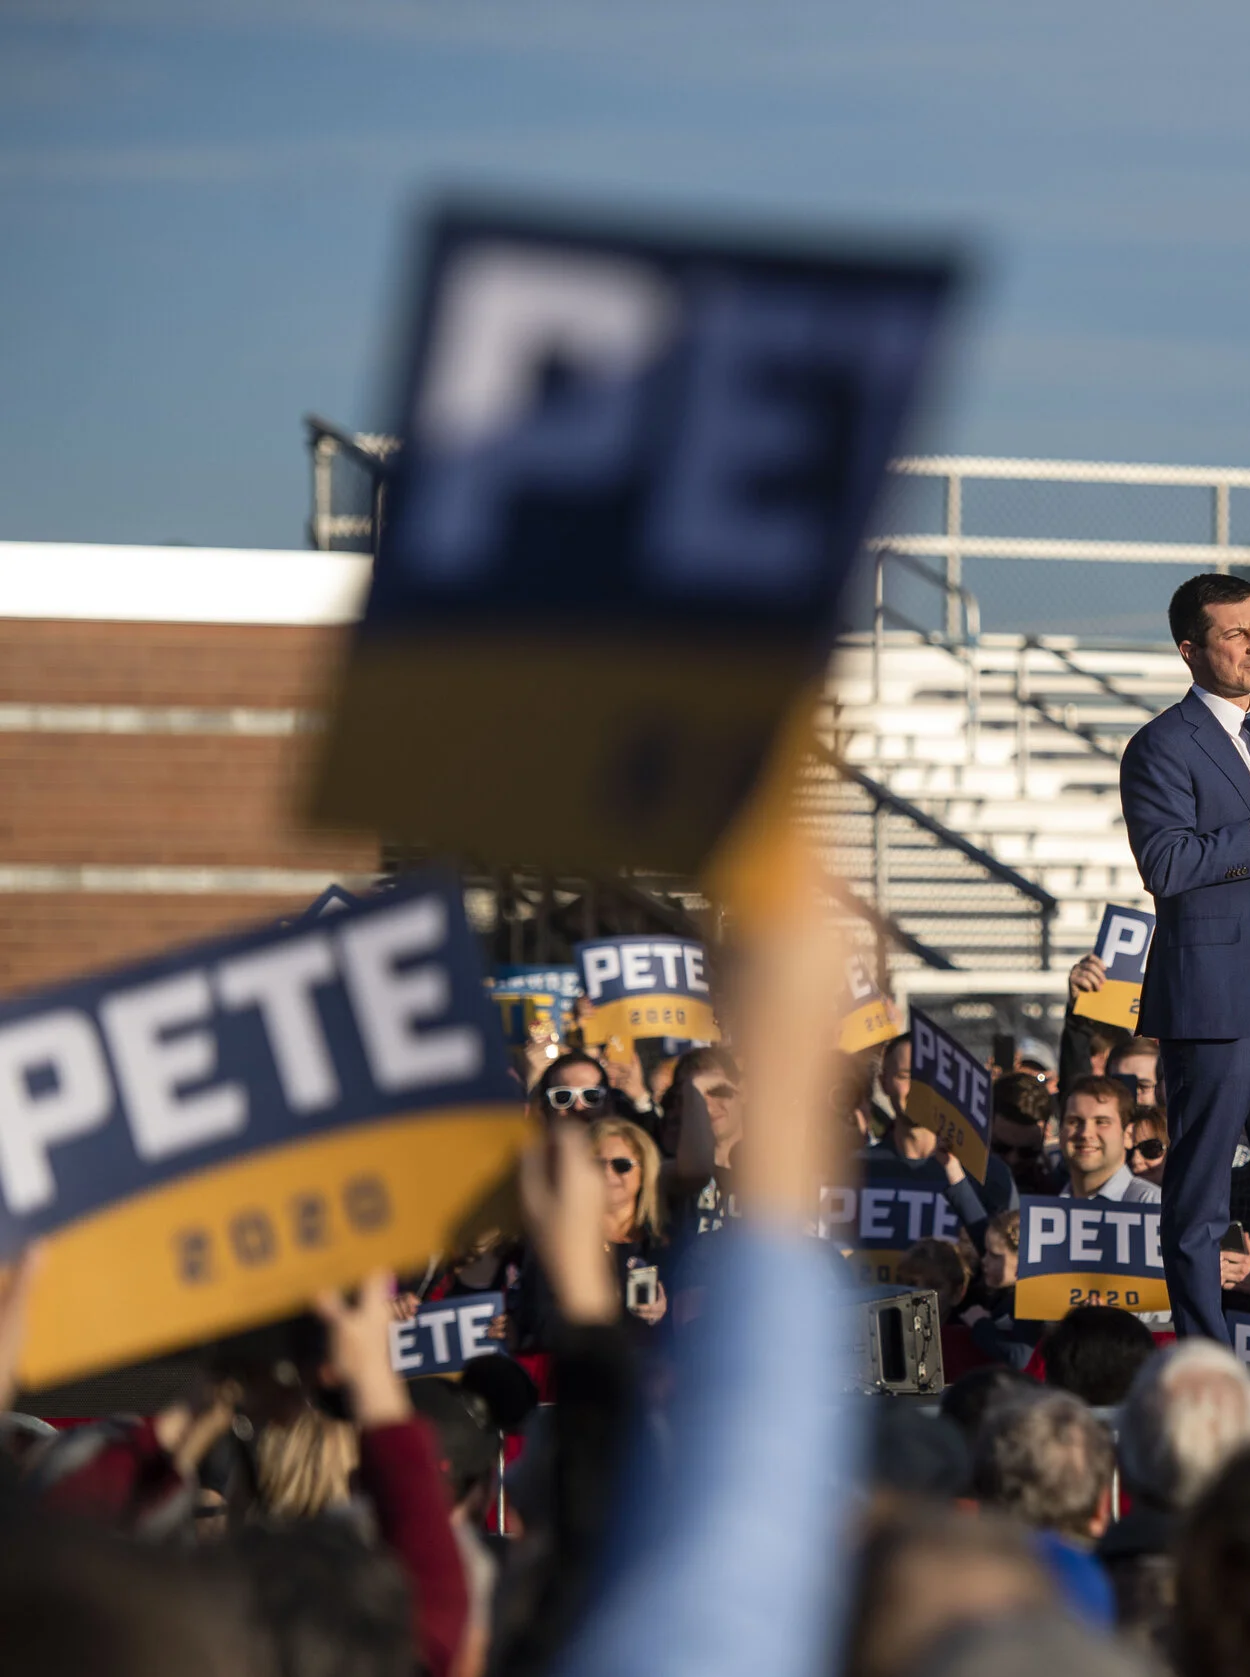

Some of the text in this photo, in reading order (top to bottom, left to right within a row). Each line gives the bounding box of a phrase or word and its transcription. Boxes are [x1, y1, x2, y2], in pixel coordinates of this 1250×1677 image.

[583, 943, 710, 998] PETE
[0, 898, 484, 1216] PETE
[630, 1008, 686, 1025] 2020
[914, 1017, 988, 1127] PETE
[172, 1172, 394, 1290] 2020
[818, 1186, 960, 1244] PETE
